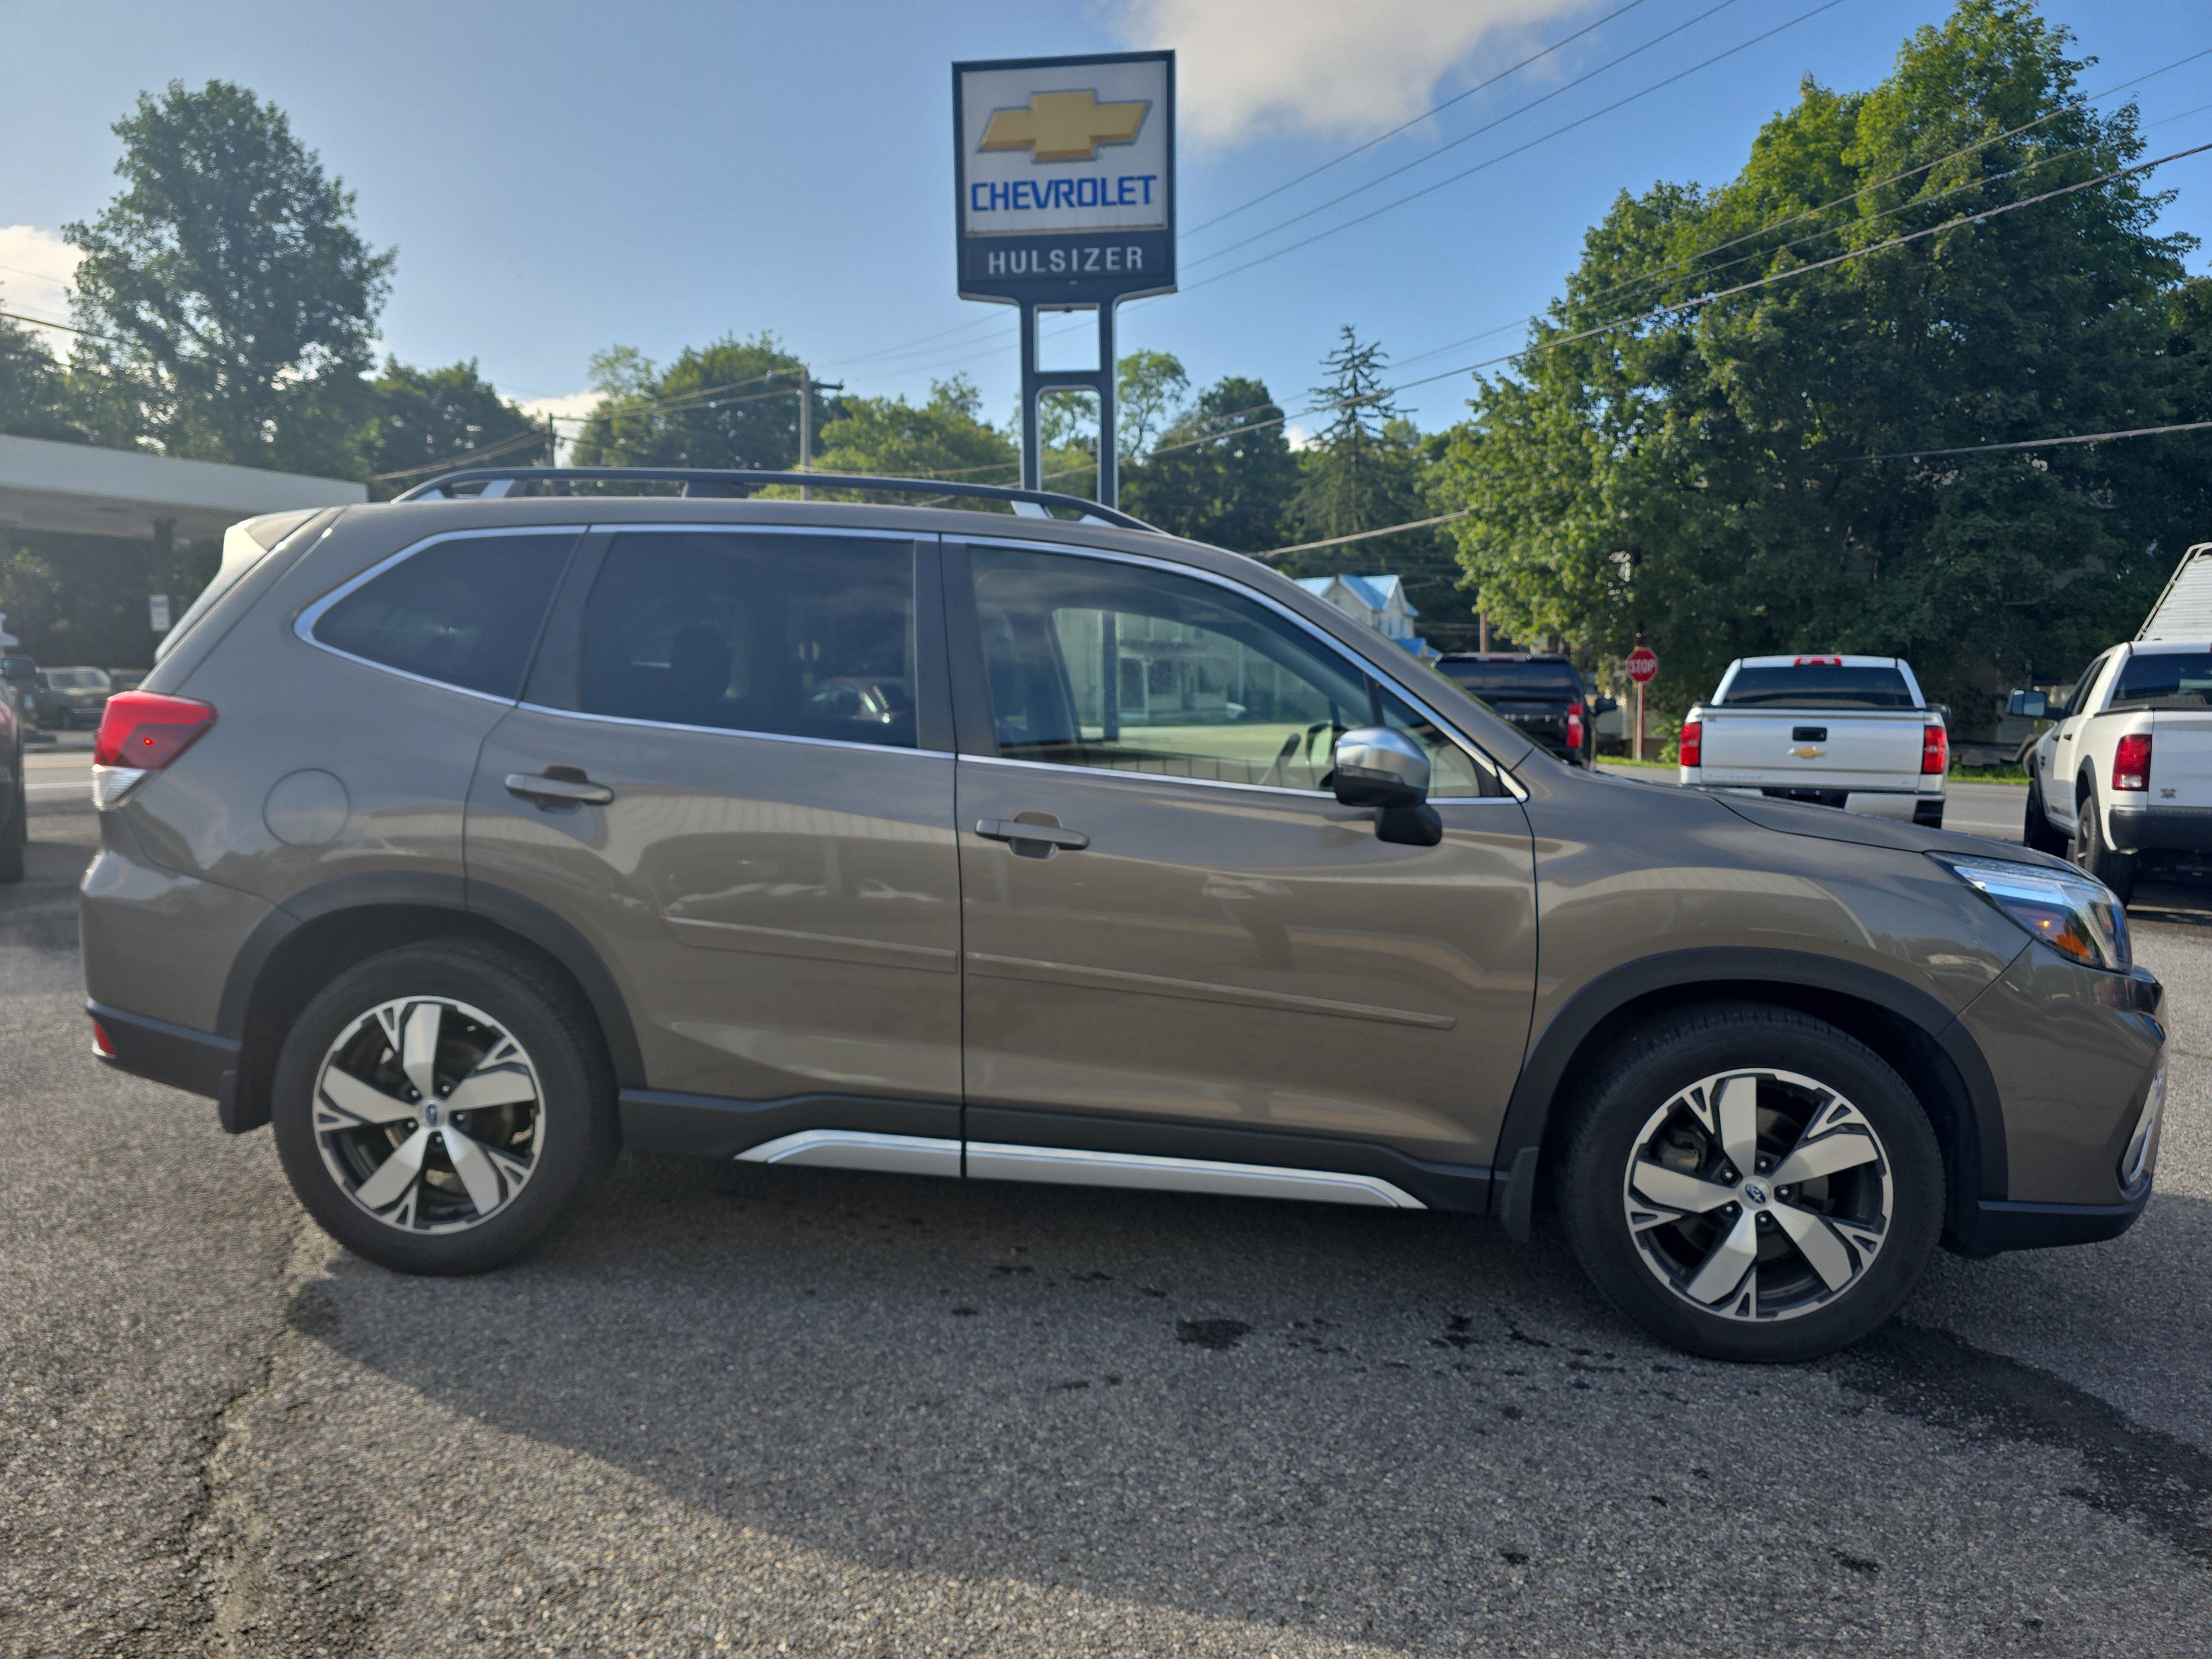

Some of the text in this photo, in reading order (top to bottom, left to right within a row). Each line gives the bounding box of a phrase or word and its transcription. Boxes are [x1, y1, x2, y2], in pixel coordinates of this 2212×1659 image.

[971, 175, 1157, 211] CHEVROLET
[988, 246, 1143, 275] HULSIZER
[1629, 658, 1655, 673] STOP
